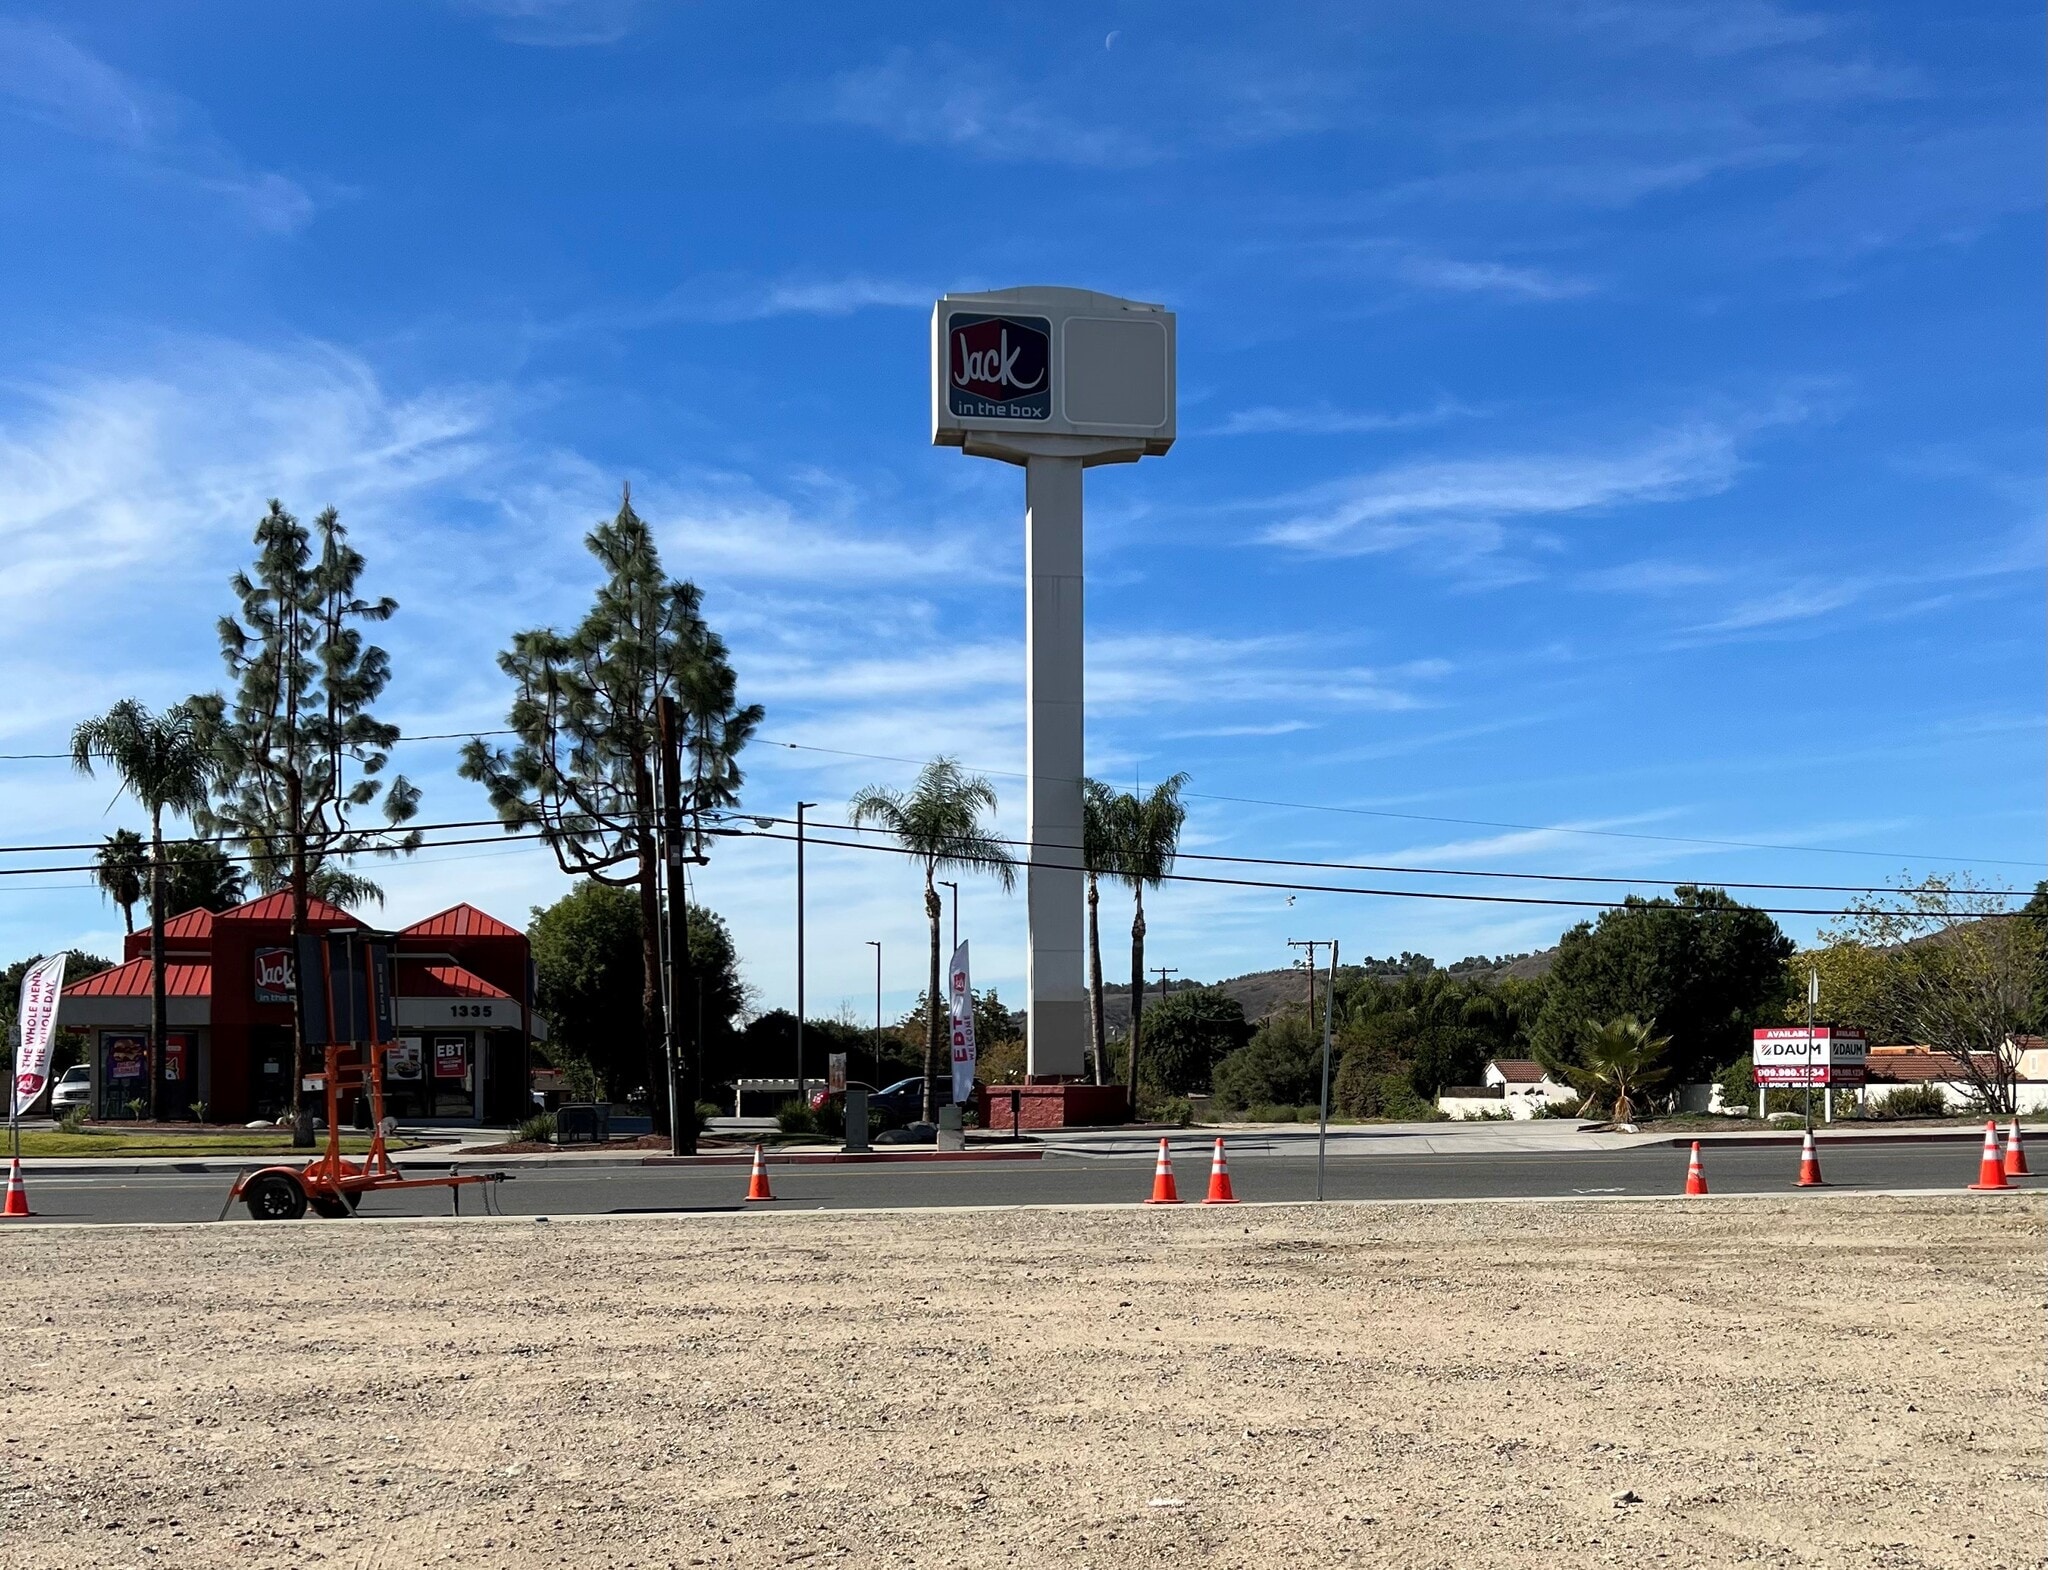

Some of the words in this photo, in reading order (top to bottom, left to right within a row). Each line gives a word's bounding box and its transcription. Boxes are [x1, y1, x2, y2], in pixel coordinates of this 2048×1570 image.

[954, 328, 1045, 390] Jack
[958, 400, 974, 416] in
[977, 401, 1006, 417] the
[1010, 402, 1042, 418] box
[256, 954, 294, 987] Jack
[29, 969, 42, 1004] MENU
[43, 980, 56, 1005] DAY.
[450, 1005, 492, 1017] 1335
[25, 1005, 38, 1045] WHOLE
[39, 1005, 52, 1045] WHOLE
[1767, 1030, 1815, 1038] AVAILABLE
[953, 1015, 968, 1062] EBT
[964, 1015, 975, 1061] WELCOME
[1774, 1044, 1821, 1055] DAUM
[1840, 1044, 1862, 1055] DAUM
[22, 1047, 33, 1068] THE
[35, 1047, 46, 1068] THE
[436, 1043, 464, 1057] EBT
